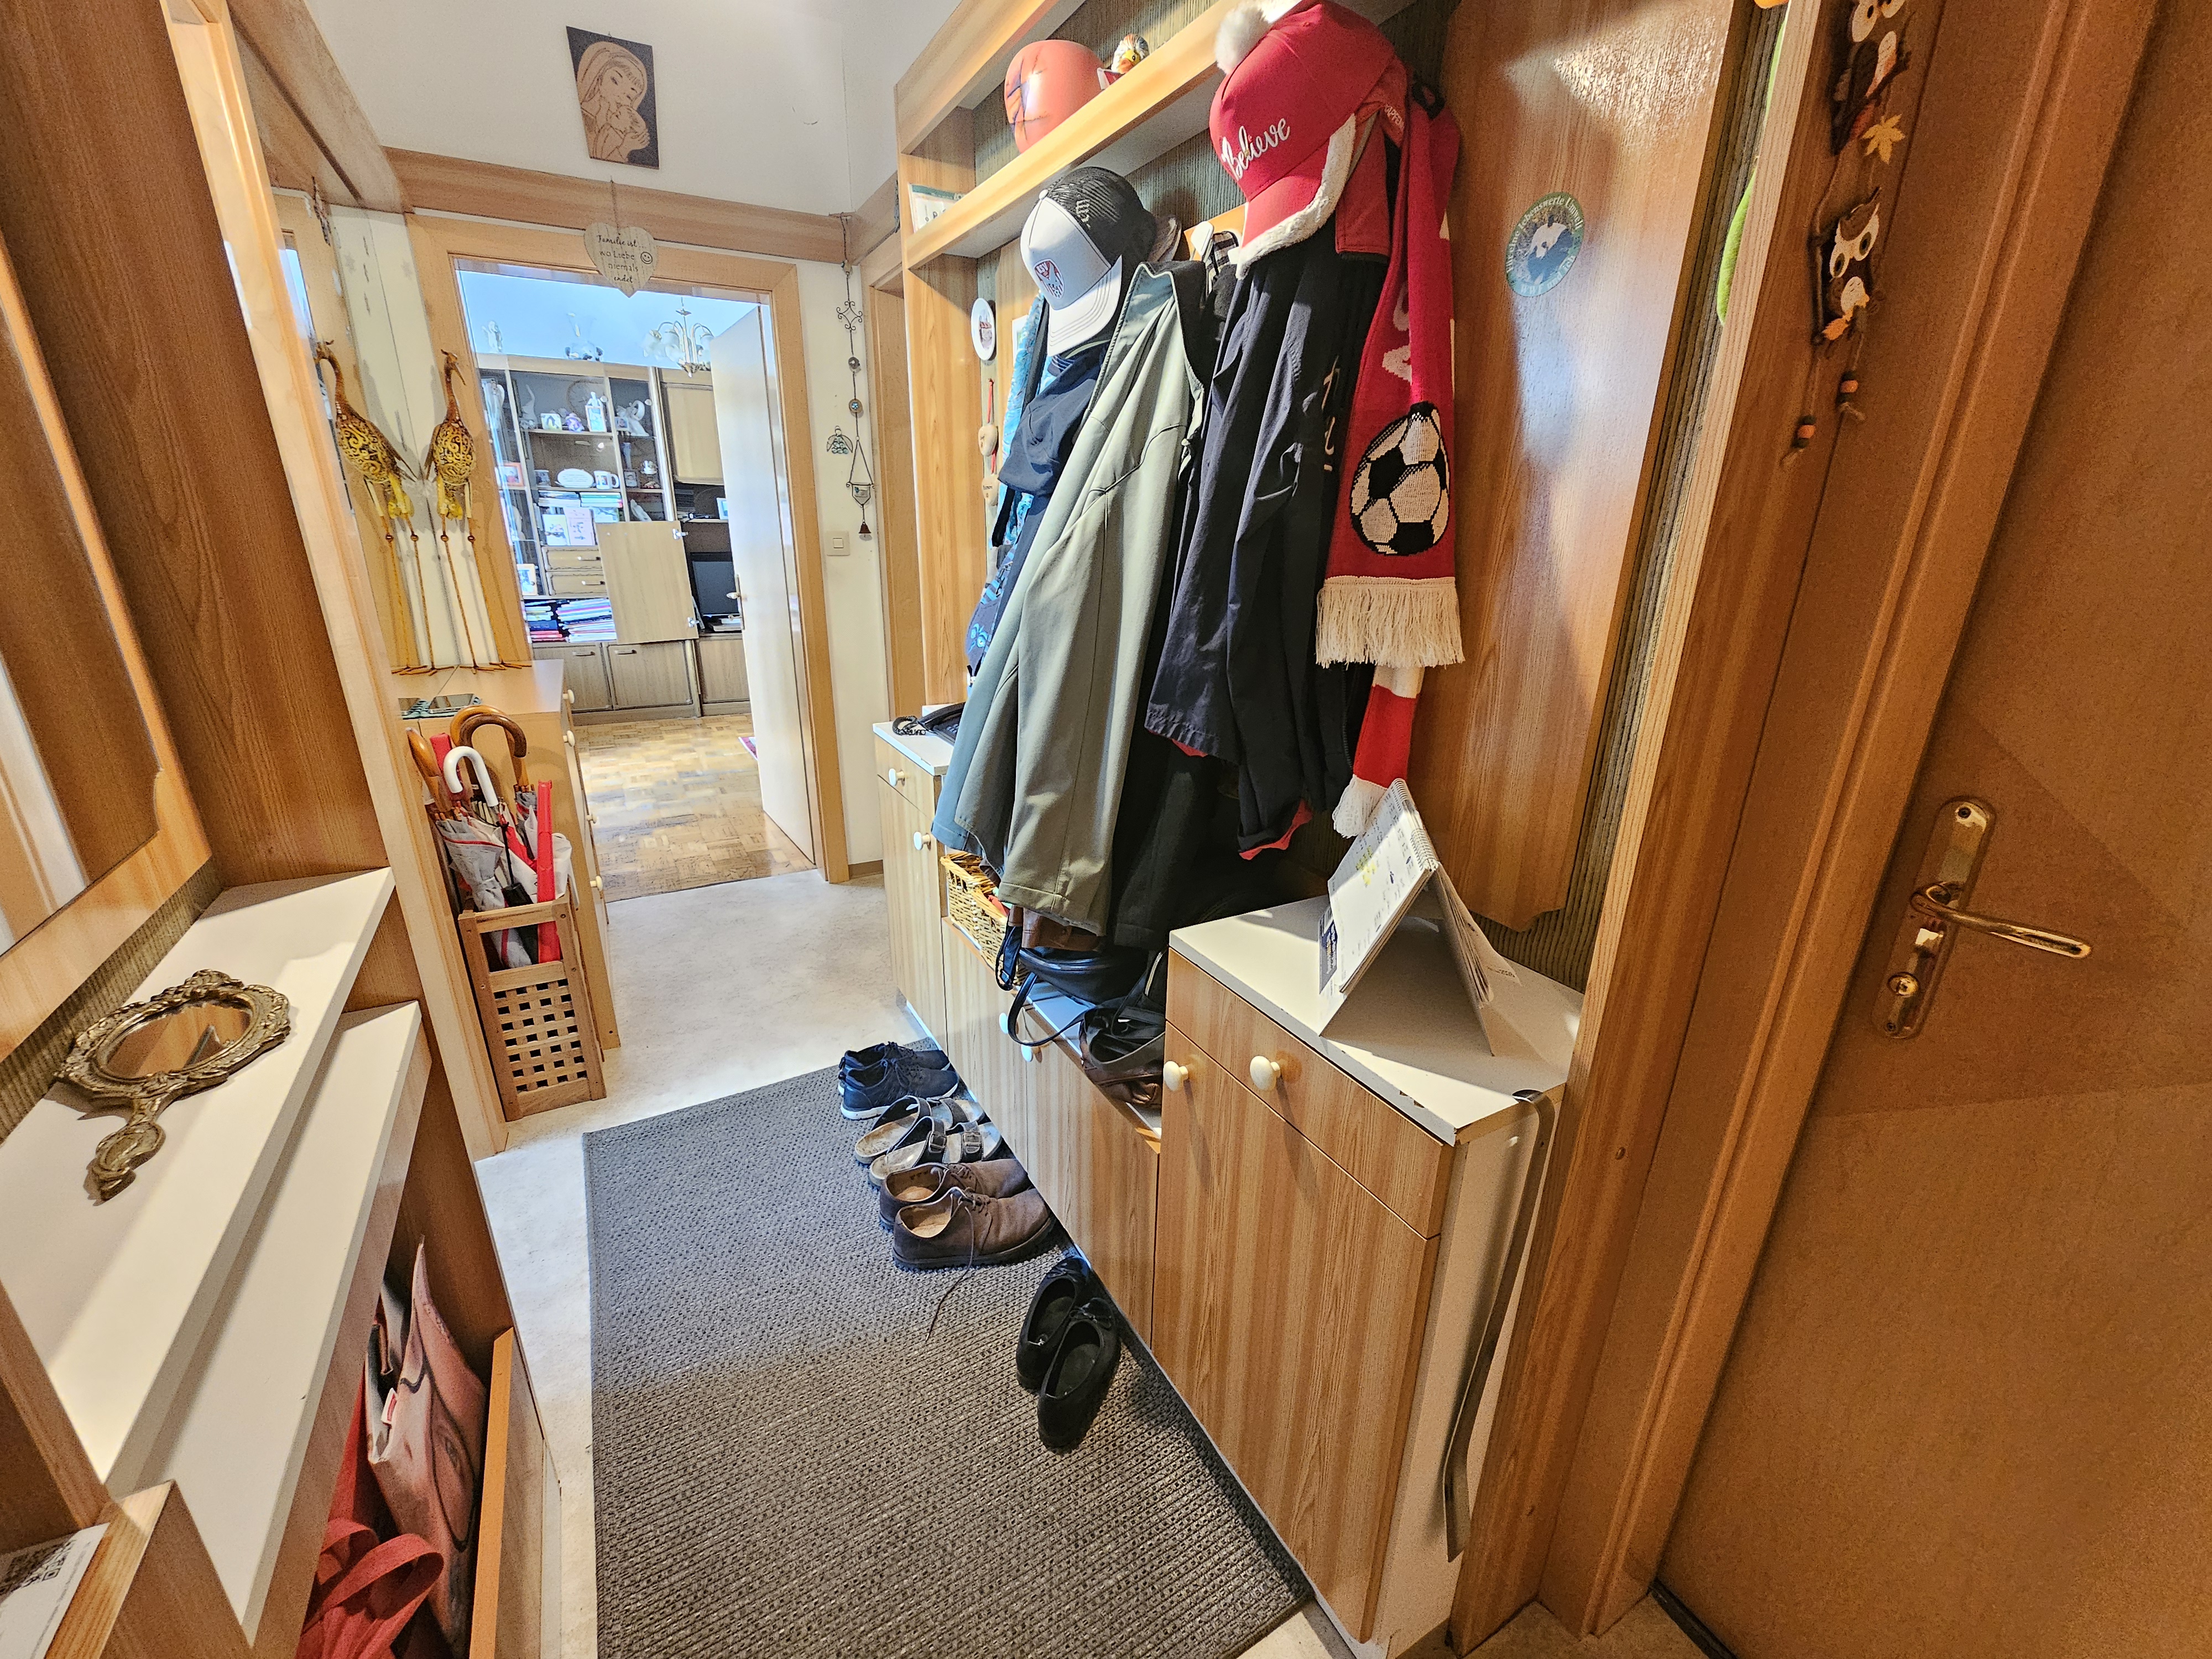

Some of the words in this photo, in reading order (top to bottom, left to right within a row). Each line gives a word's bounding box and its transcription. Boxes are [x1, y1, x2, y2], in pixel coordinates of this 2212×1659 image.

[1221, 118, 1290, 182] Believe
[1509, 230, 1520, 253] eine
[1518, 196, 1565, 229] lebenswerte
[1565, 197, 1583, 230] Umwelt
[597, 234, 626, 246] Familie
[613, 250, 635, 260] Liebe
[608, 263, 638, 272] niemals
[613, 274, 633, 284] endet
[1521, 283, 1545, 295] WWF
[1547, 272, 1564, 288] und
[1562, 255, 1577, 272] ich
